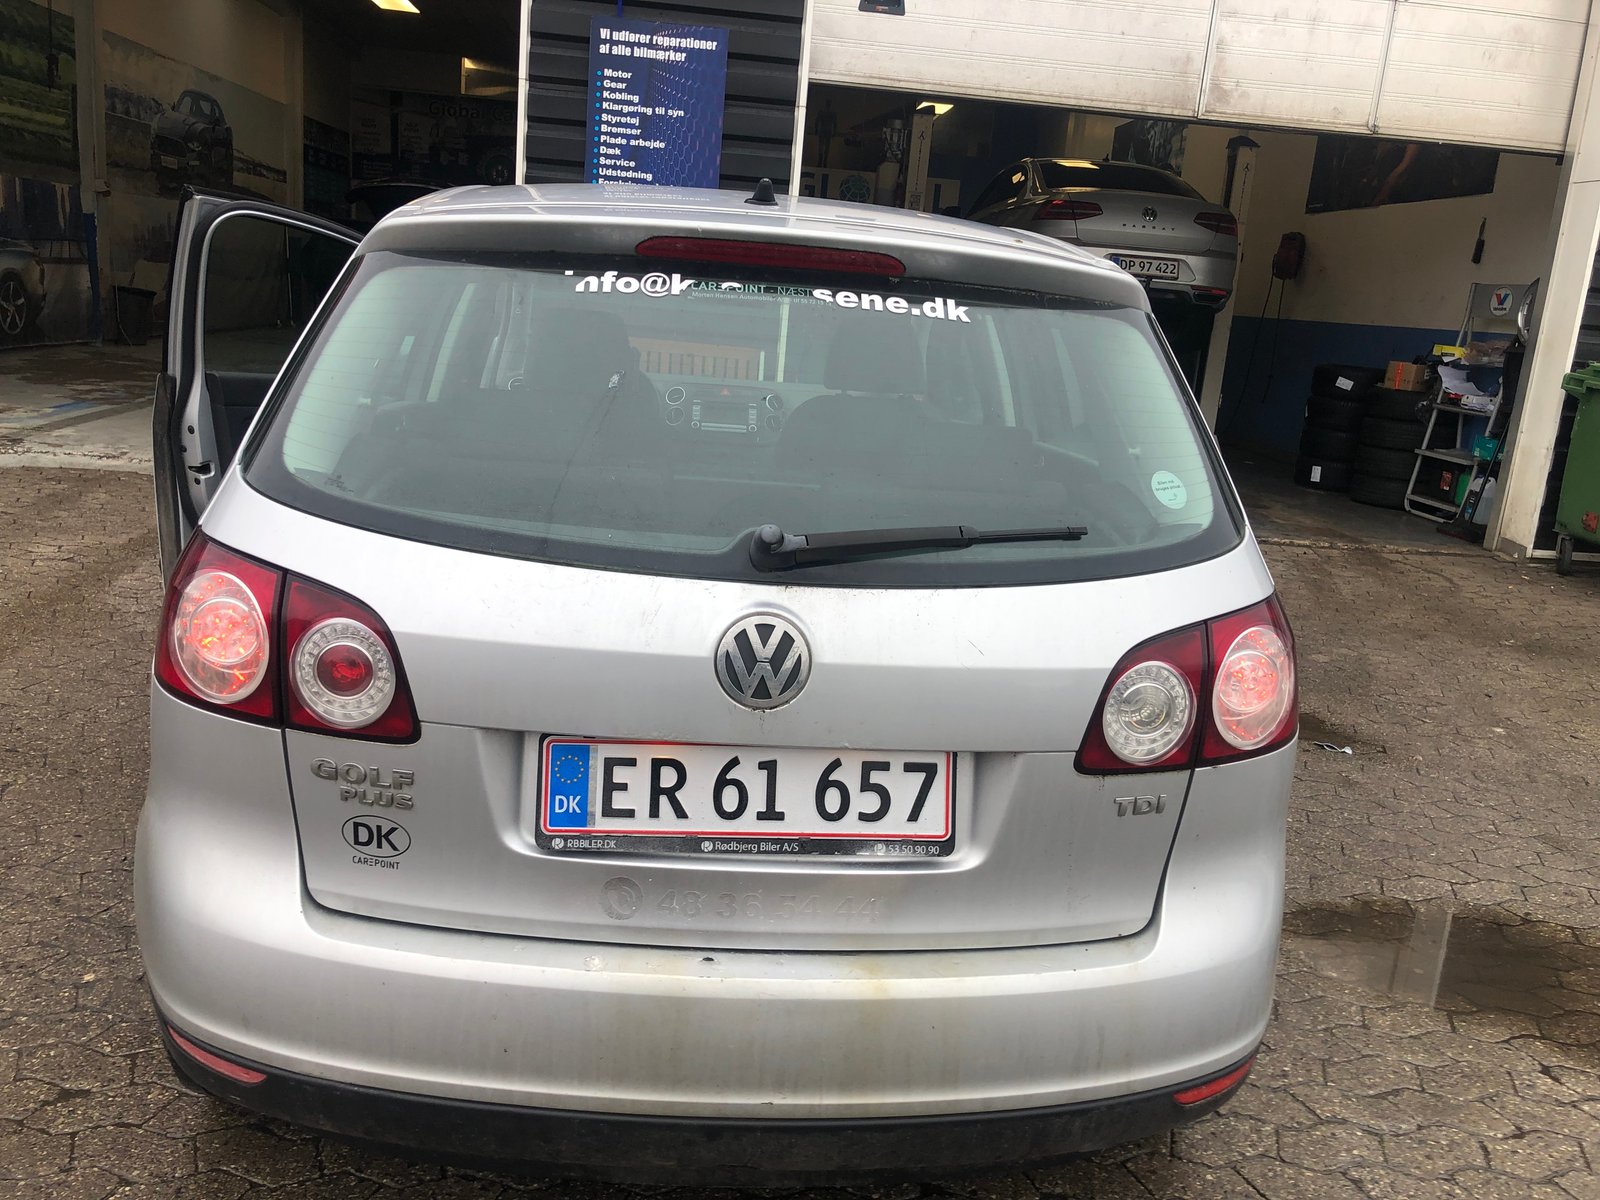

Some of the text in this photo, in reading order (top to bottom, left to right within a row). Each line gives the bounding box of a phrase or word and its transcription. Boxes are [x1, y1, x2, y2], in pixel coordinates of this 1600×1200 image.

[600, 28, 717, 50] Vi udfører reparationer
[600, 44, 686, 62] af alle bilmærker
[604, 68, 632, 79] Motor
[604, 80, 627, 89] Gear
[603, 91, 639, 102] Kobling
[602, 102, 684, 117] Klargøring til syn
[601, 114, 640, 126] Styretøj
[601, 124, 641, 135] Bremser
[600, 135, 665, 149] Plade arbejde
[600, 146, 621, 156] Dæk
[600, 157, 635, 167] Service
[599, 168, 653, 181] Udstødning
[1120, 260, 1176, 274] DP 97 422
[564, 270, 696, 298] nfo@k
[311, 757, 414, 790] GOLF
[554, 755, 938, 823] DK ER 61 657
[340, 785, 414, 810] PLUS
[1114, 794, 1166, 817] TDI
[353, 822, 400, 852] DK
[567, 839, 616, 849] RBBILER.DK
[716, 841, 799, 853] Rødbjerg Biler A/S
[888, 844, 940, 854] 53 50 90 90
[352, 856, 400, 870] CAREPOINT
